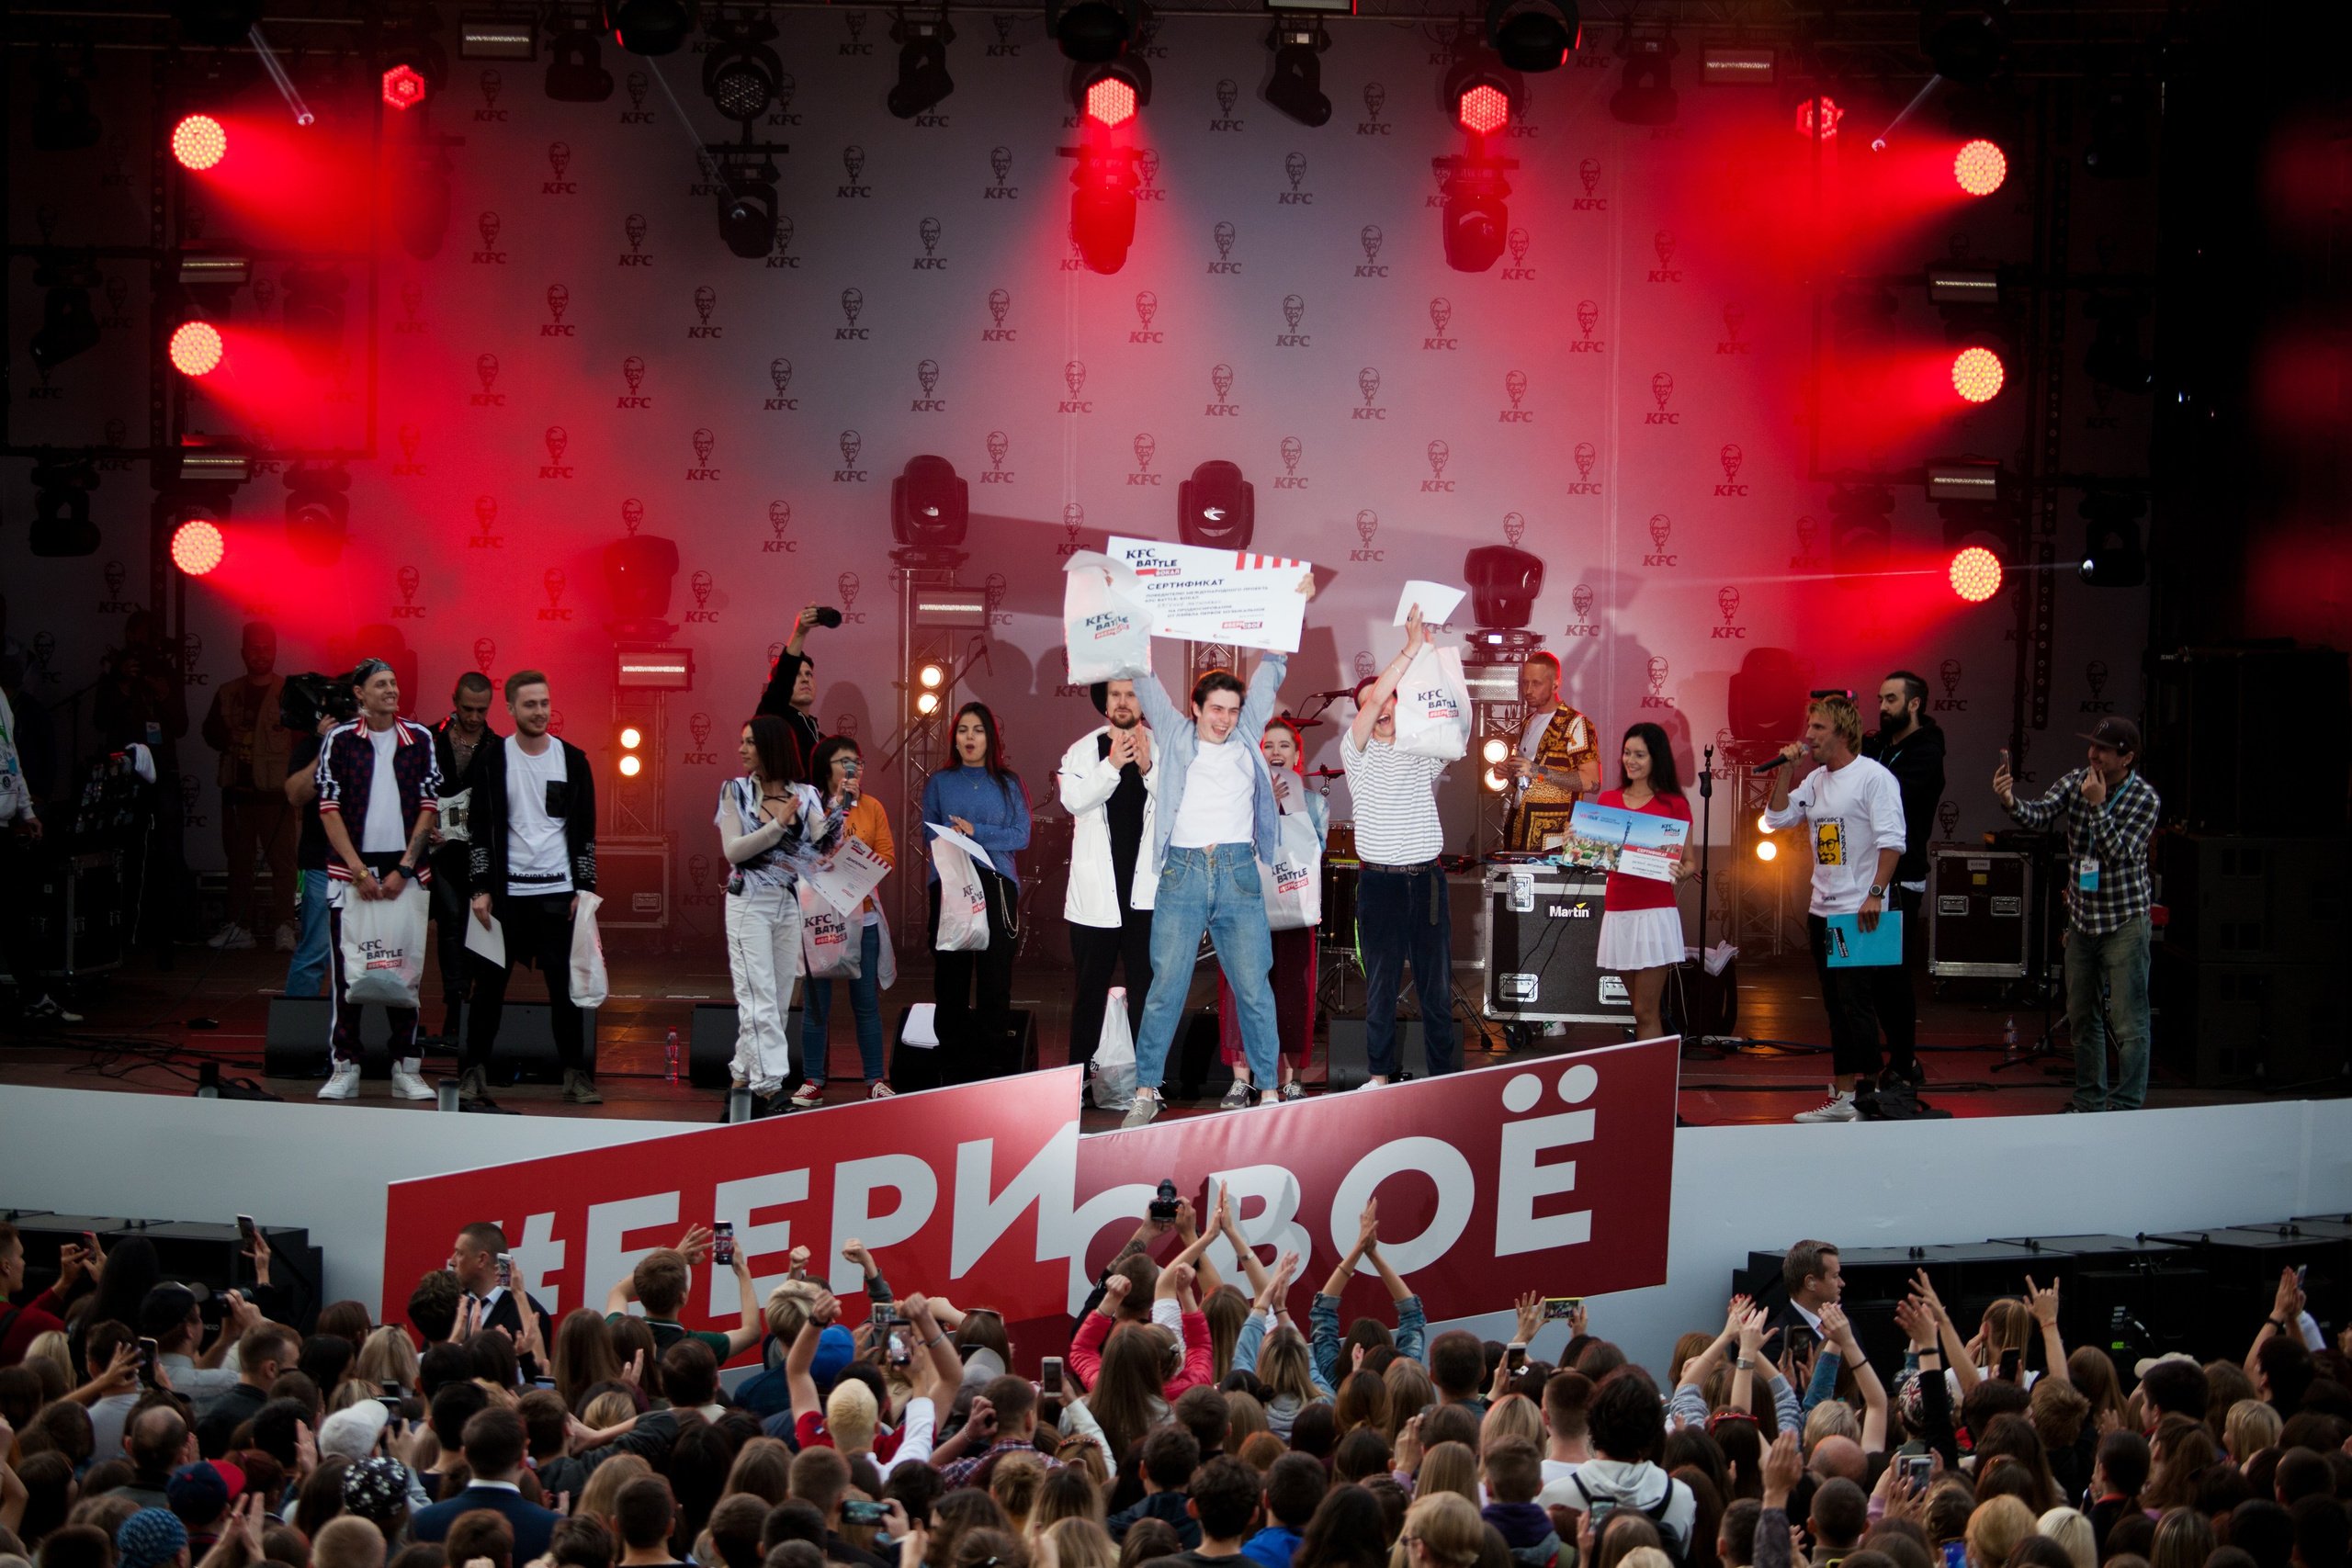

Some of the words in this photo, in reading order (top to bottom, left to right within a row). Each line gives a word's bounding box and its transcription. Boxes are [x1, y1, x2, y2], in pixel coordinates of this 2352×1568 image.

[691, 41, 715, 53] KF
[838, 44, 873, 56] KFC
[986, 45, 1021, 57] KFC
[1575, 56, 1610, 68] KFC
[473, 110, 509, 122] KFC
[619, 112, 655, 124] KFC
[767, 113, 803, 126] KFC
[914, 115, 950, 128] KFC
[1209, 119, 1244, 131] KFC
[1356, 123, 1391, 135] KFC
[1504, 125, 1539, 138] KFC
[1650, 127, 1685, 140] KFC
[542, 182, 577, 195] KFC
[836, 186, 871, 198] KFC
[983, 187, 1018, 199] KFC
[1278, 192, 1313, 205] KFC
[1426, 195, 1449, 208] KF
[1572, 198, 1607, 210] KFC
[471, 252, 507, 265] KFC
[618, 254, 654, 266] KFC
[765, 256, 801, 268] KFC
[912, 258, 948, 270] KFC
[1206, 262, 1242, 275] KFC
[1354, 265, 1390, 277] KFC
[1501, 268, 1537, 280] KFC
[1647, 271, 1683, 283] KFC
[99, 316, 135, 329] KFC
[393, 321, 429, 333] KFC
[540, 324, 576, 336] KFC
[687, 327, 723, 339] KFC
[834, 327, 870, 340] KFC
[981, 329, 1017, 342] KFC
[1128, 331, 1164, 344] KFC
[1275, 335, 1311, 347] KFC
[1422, 338, 1458, 350] KFC
[1569, 340, 1605, 353] KFC
[1716, 342, 1752, 355] KFC
[28, 387, 63, 400] KFC
[469, 394, 505, 406] KFC
[616, 396, 652, 409] KFC
[763, 398, 799, 411] KFC
[910, 399, 946, 412] KFC
[1057, 401, 1093, 413] KFC
[1204, 404, 1240, 416] KFC
[1351, 407, 1387, 420] KFC
[1498, 410, 1534, 423] KFC
[1645, 412, 1680, 424] KFC
[2085, 417, 2120, 429] KFC
[98, 459, 134, 471] KFC
[392, 463, 428, 476] KFC
[538, 466, 574, 479] KFC
[685, 469, 721, 481] KFC
[832, 470, 868, 482] KFC
[979, 472, 1015, 484] KFC
[1126, 474, 1162, 486] KFC
[1273, 477, 1309, 490] KFC
[1420, 480, 1456, 492] KFC
[1567, 483, 1603, 495] KFC
[1713, 485, 1749, 497] KFC
[469, 536, 504, 548] KFC
[762, 541, 797, 553] KFC
[1125, 548, 1155, 559] KFC
[1349, 550, 1384, 562] KFC
[1136, 558, 1177, 568] BATTLE
[1642, 554, 1677, 567] KFC
[1790, 556, 1825, 569] KFC
[1148, 579, 1225, 590] СЕРТИФИКАТ
[97, 601, 133, 614] KFC
[243, 603, 279, 615] KFC
[390, 606, 426, 618] KFC
[537, 609, 572, 621] KFC
[684, 610, 720, 623] KFC
[1086, 612, 1113, 626] KFC
[1565, 624, 1600, 637] KFC
[1711, 627, 1746, 639] KFC
[40, 671, 62, 683] FC
[184, 673, 209, 685] FC
[1053, 686, 1088, 698] KFC
[1418, 689, 1443, 701] KFC
[1640, 696, 1675, 708] KFC
[1933, 699, 1968, 711] KFC
[2079, 700, 2115, 713] KFC
[683, 753, 718, 765] KFC
[1711, 768, 1733, 781] KF
[184, 816, 208, 828] FC
[1637, 847, 1668, 858] СЕРТИФИКАТ
[1277, 868, 1307, 884] BATTLE
[682, 894, 717, 907] KFC
[1549, 905, 1589, 918] Martin
[804, 914, 832, 928] KFC
[357, 939, 382, 953] KFC
[367, 949, 403, 960] BATTLE
